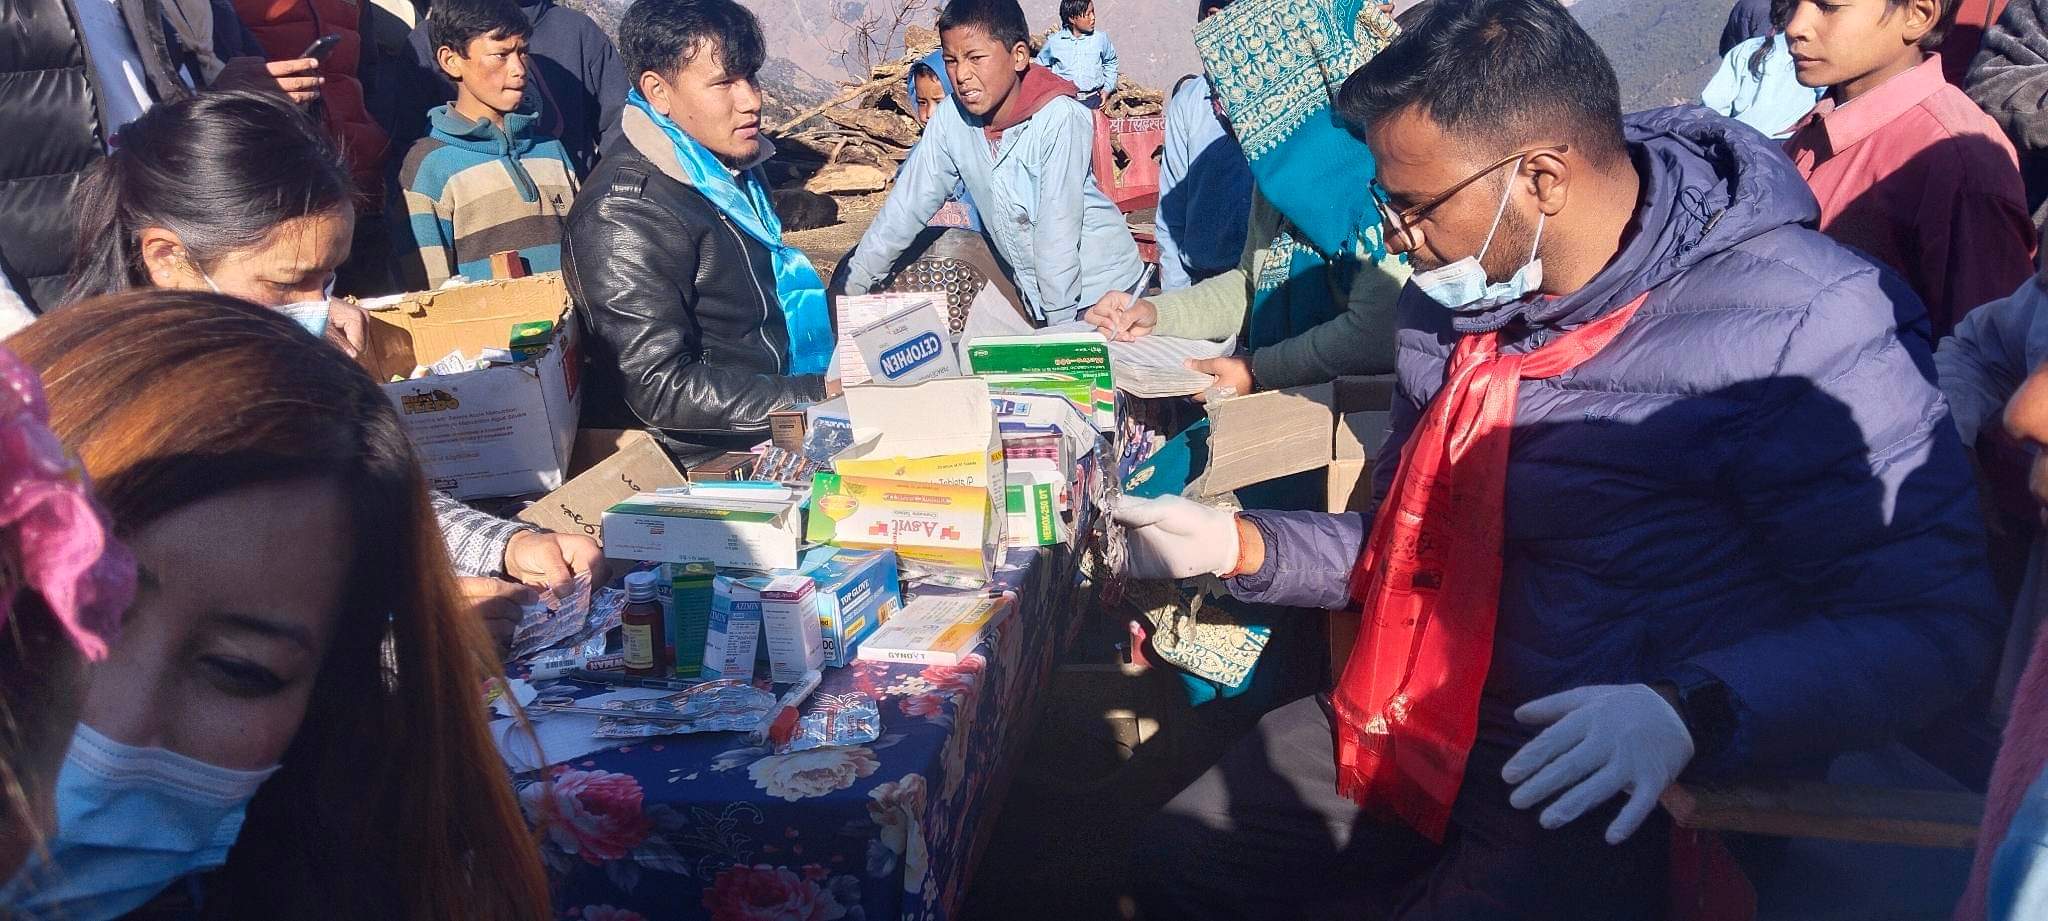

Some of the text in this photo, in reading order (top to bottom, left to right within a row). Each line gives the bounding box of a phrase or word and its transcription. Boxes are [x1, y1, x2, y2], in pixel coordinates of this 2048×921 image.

[881, 336, 939, 375] CETOPHEN
[892, 519, 938, 537] Asvit
[841, 579, 870, 605] TOP GLOVE
